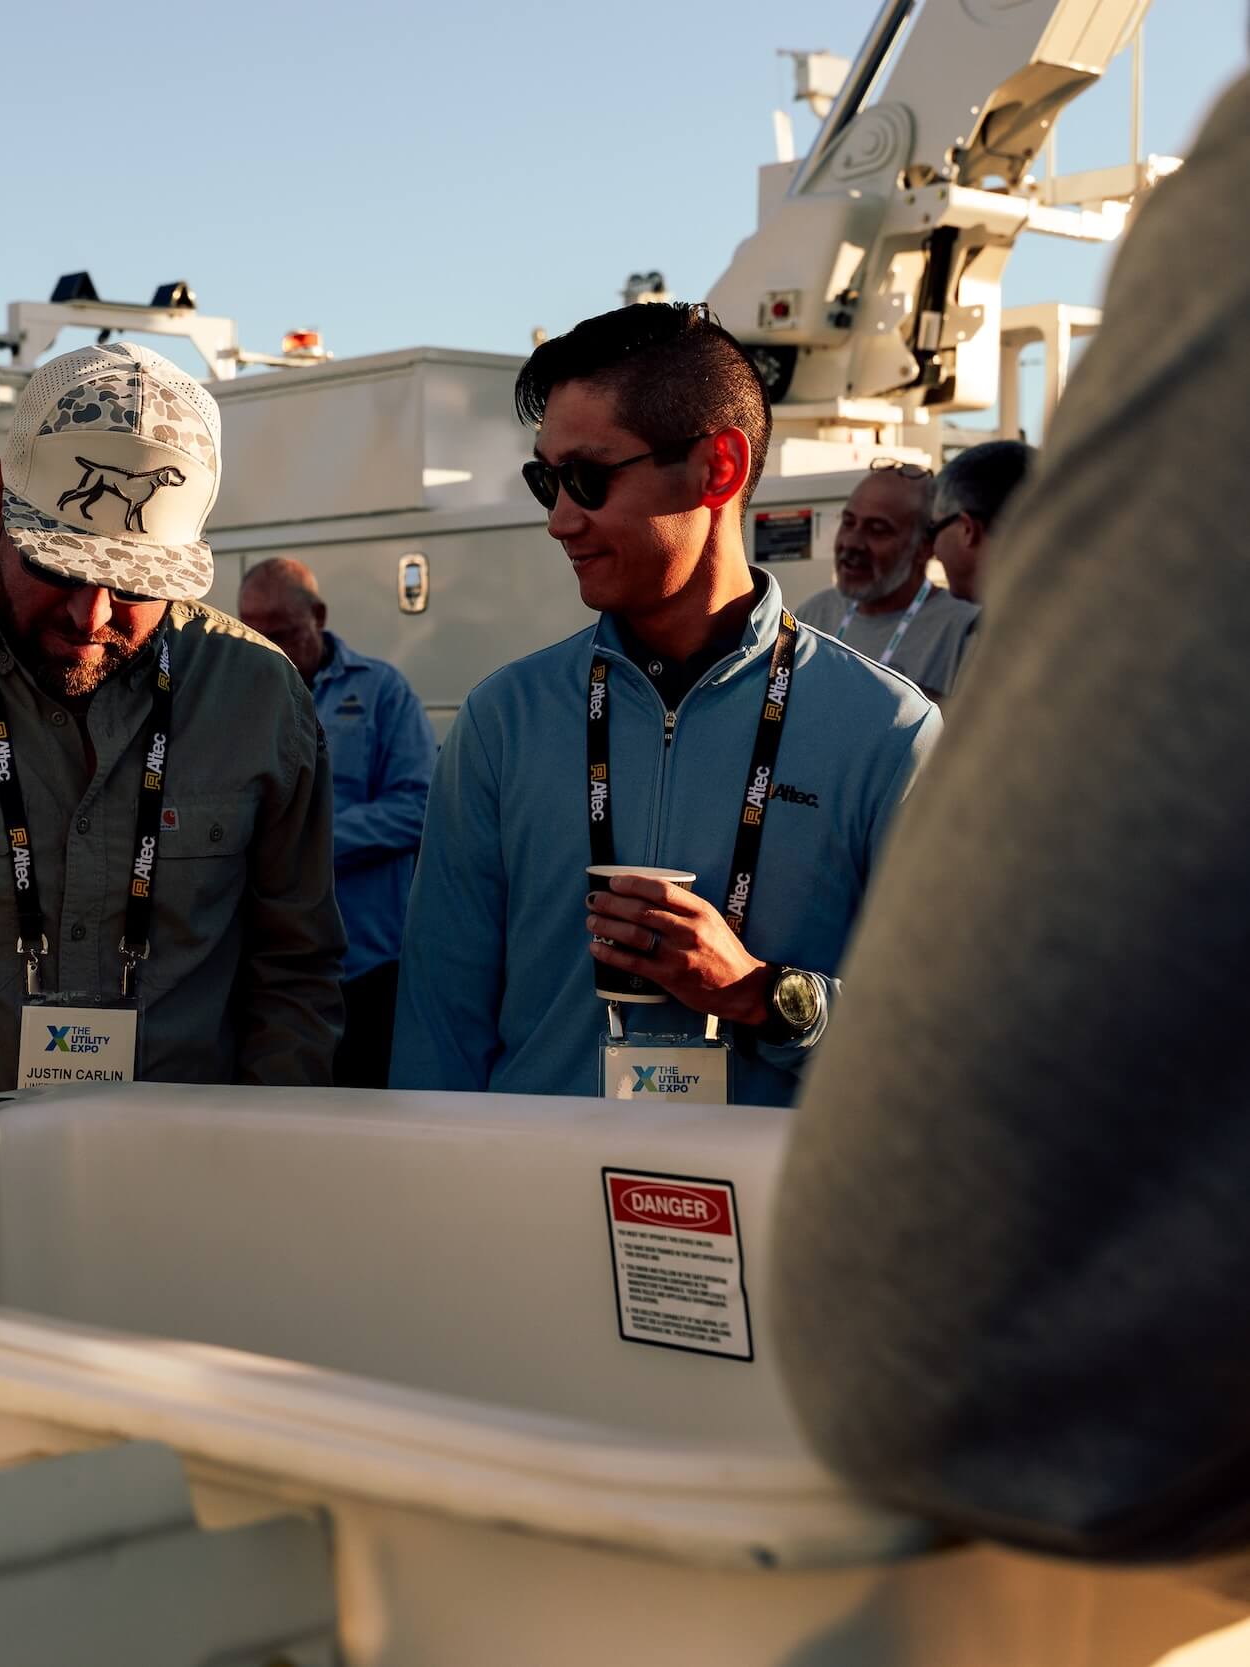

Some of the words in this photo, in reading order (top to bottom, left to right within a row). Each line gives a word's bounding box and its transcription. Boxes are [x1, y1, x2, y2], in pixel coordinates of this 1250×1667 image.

[767, 666, 790, 706] Altec
[590, 682, 606, 720] Altec
[147, 733, 166, 774] Altec
[591, 781, 607, 821] Altec
[746, 766, 770, 810] Altec
[773, 783, 817, 807] Altec
[12, 846, 30, 890] Altec
[135, 836, 155, 880] Altec
[729, 873, 751, 917] Altec
[71, 1026, 91, 1035] THE
[71, 1036, 110, 1045] UTILITY
[70, 1045, 99, 1053] EXPO
[26, 1067, 72, 1080] JUSTIN
[75, 1069, 123, 1081] CARLIN
[659, 1066, 679, 1075] THE
[659, 1075, 700, 1085] UTILITY
[659, 1085, 689, 1093] EXPO
[631, 1192, 709, 1220] DANGER
